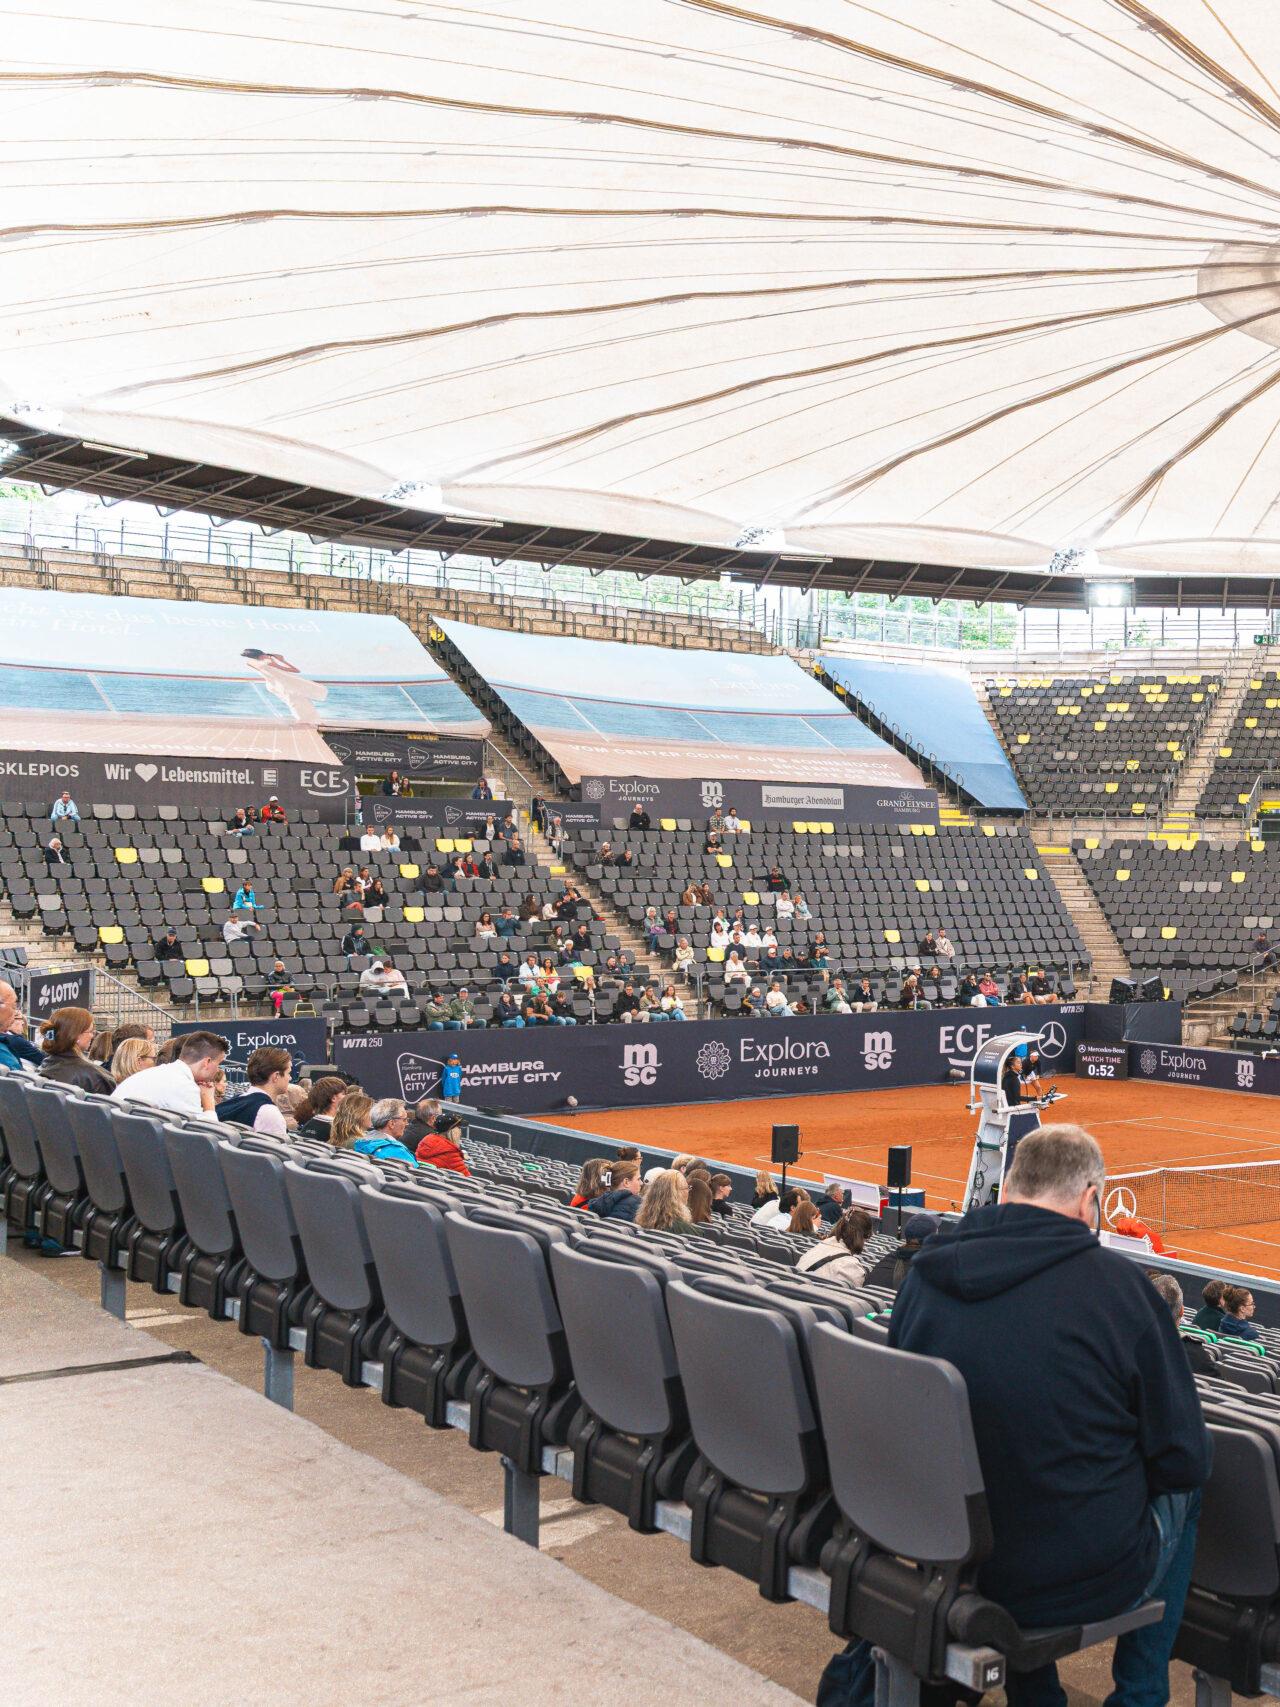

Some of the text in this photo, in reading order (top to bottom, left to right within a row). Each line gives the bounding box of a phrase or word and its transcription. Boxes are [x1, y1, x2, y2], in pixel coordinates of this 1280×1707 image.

[104, 763, 254, 785] Wir Lebensmittel.
[300, 769, 341, 788] ECE
[610, 779, 661, 796] Explora
[764, 794, 805, 806] Hamburger
[876, 799, 936, 809] GRAND ELYSEE
[51, 981, 79, 1003] LOTTO
[1060, 1005, 1075, 1014] WTA
[237, 1031, 297, 1050] Explora
[342, 1037, 383, 1048] WTA 250
[740, 1036, 831, 1066] Explora
[1088, 1046, 1126, 1054] Mercedes-Benz
[1082, 1055, 1121, 1064] MATCH TIME
[1160, 1050, 1207, 1071] Explora
[461, 1060, 545, 1074] HAMBURG
[754, 1065, 819, 1078] JOURNEYS
[1088, 1064, 1114, 1077] 0:52
[404, 1072, 438, 1081] ACTIVE
[460, 1074, 519, 1087] ACTIVE
[523, 1071, 562, 1084] CITY
[1168, 1071, 1200, 1080] JOURNEYS
[405, 1082, 426, 1091] CITY
[986, 1666, 999, 1682] 16
